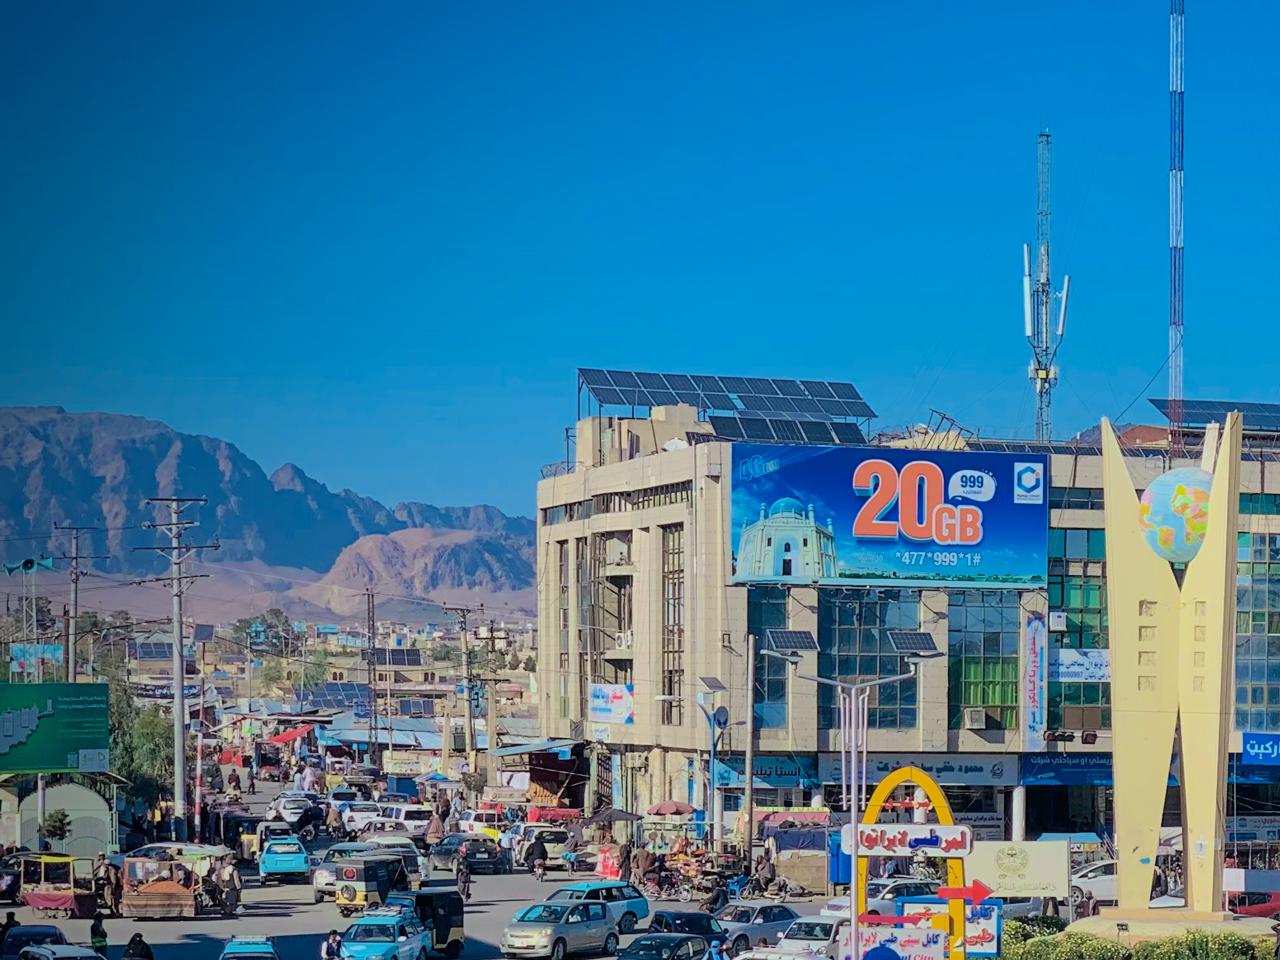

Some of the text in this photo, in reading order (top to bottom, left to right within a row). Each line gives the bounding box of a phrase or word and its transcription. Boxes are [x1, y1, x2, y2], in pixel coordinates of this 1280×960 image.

[853, 459, 944, 540] 20
[960, 475, 984, 489] 999
[933, 505, 983, 545] GB
